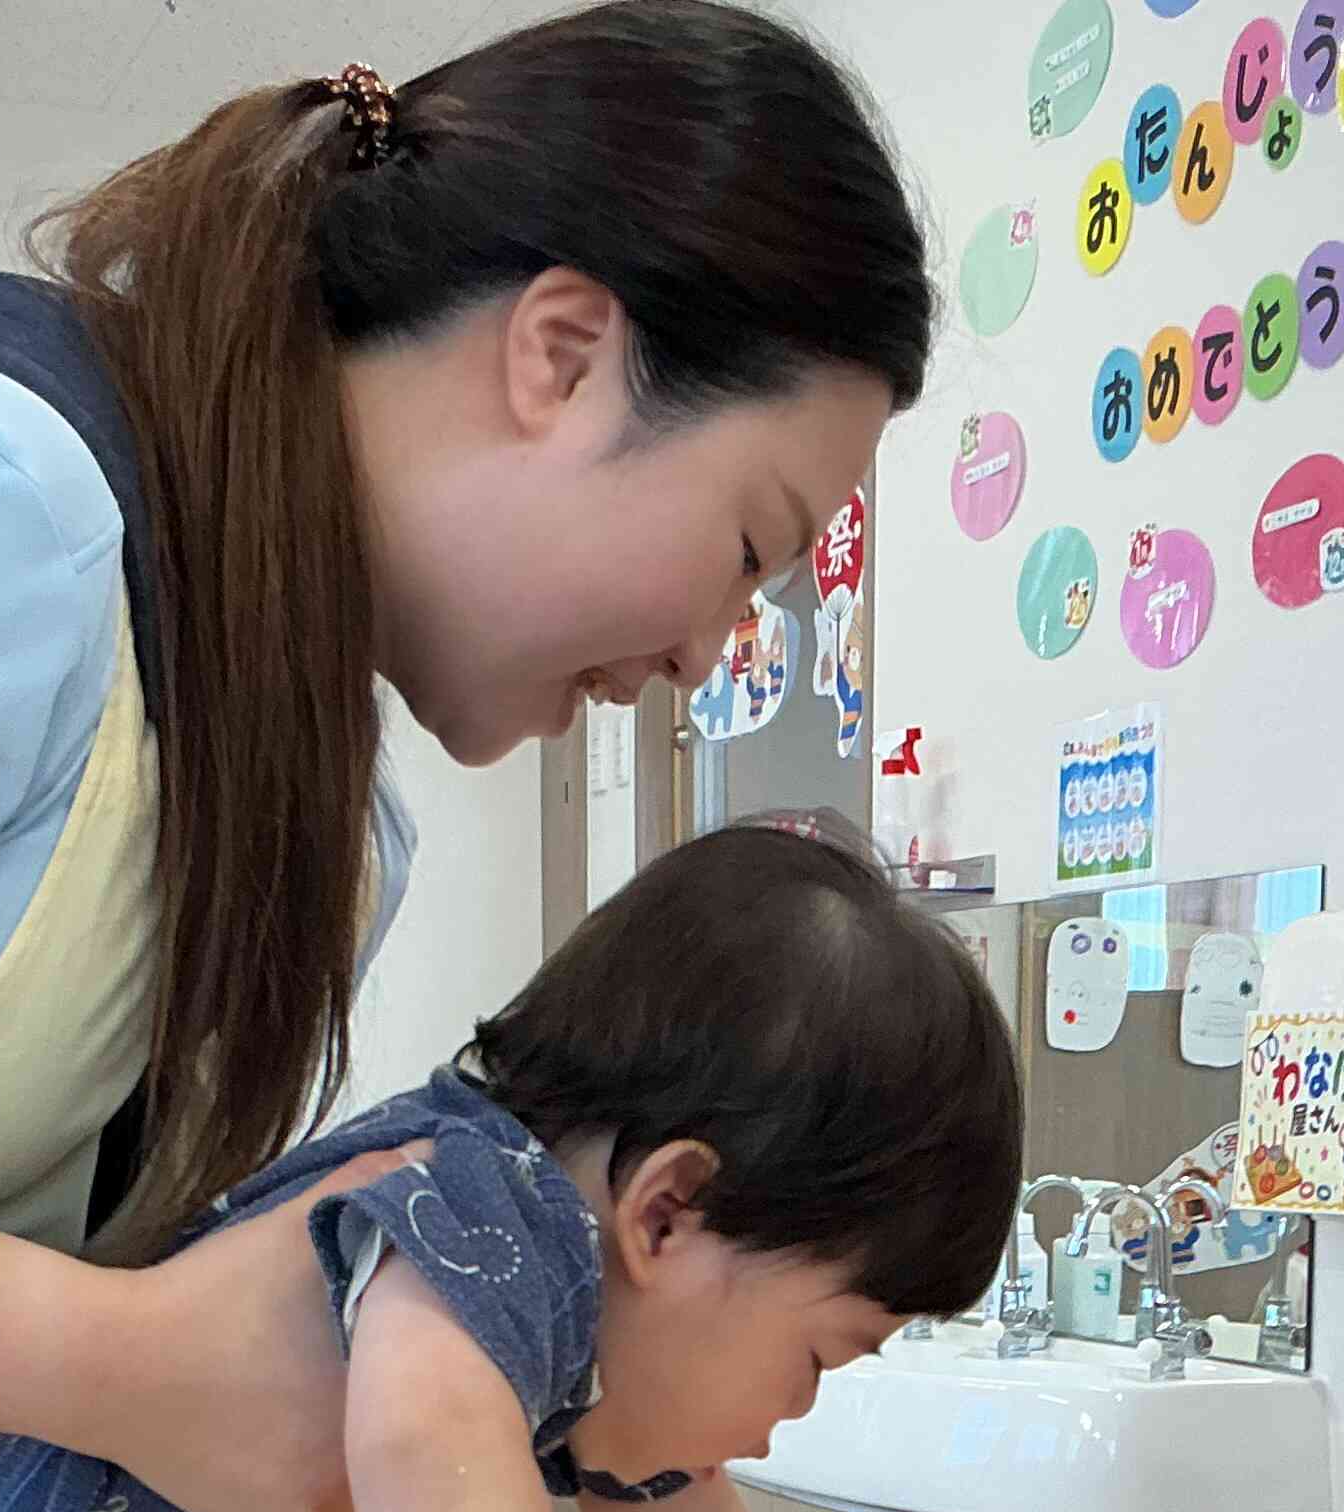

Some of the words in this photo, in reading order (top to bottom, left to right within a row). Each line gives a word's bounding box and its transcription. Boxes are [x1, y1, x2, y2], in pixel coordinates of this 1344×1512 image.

[1103, 266, 1341, 440] おめでとう
[826, 503, 854, 577] 祭
[1289, 1103, 1340, 1136] 屋さん
